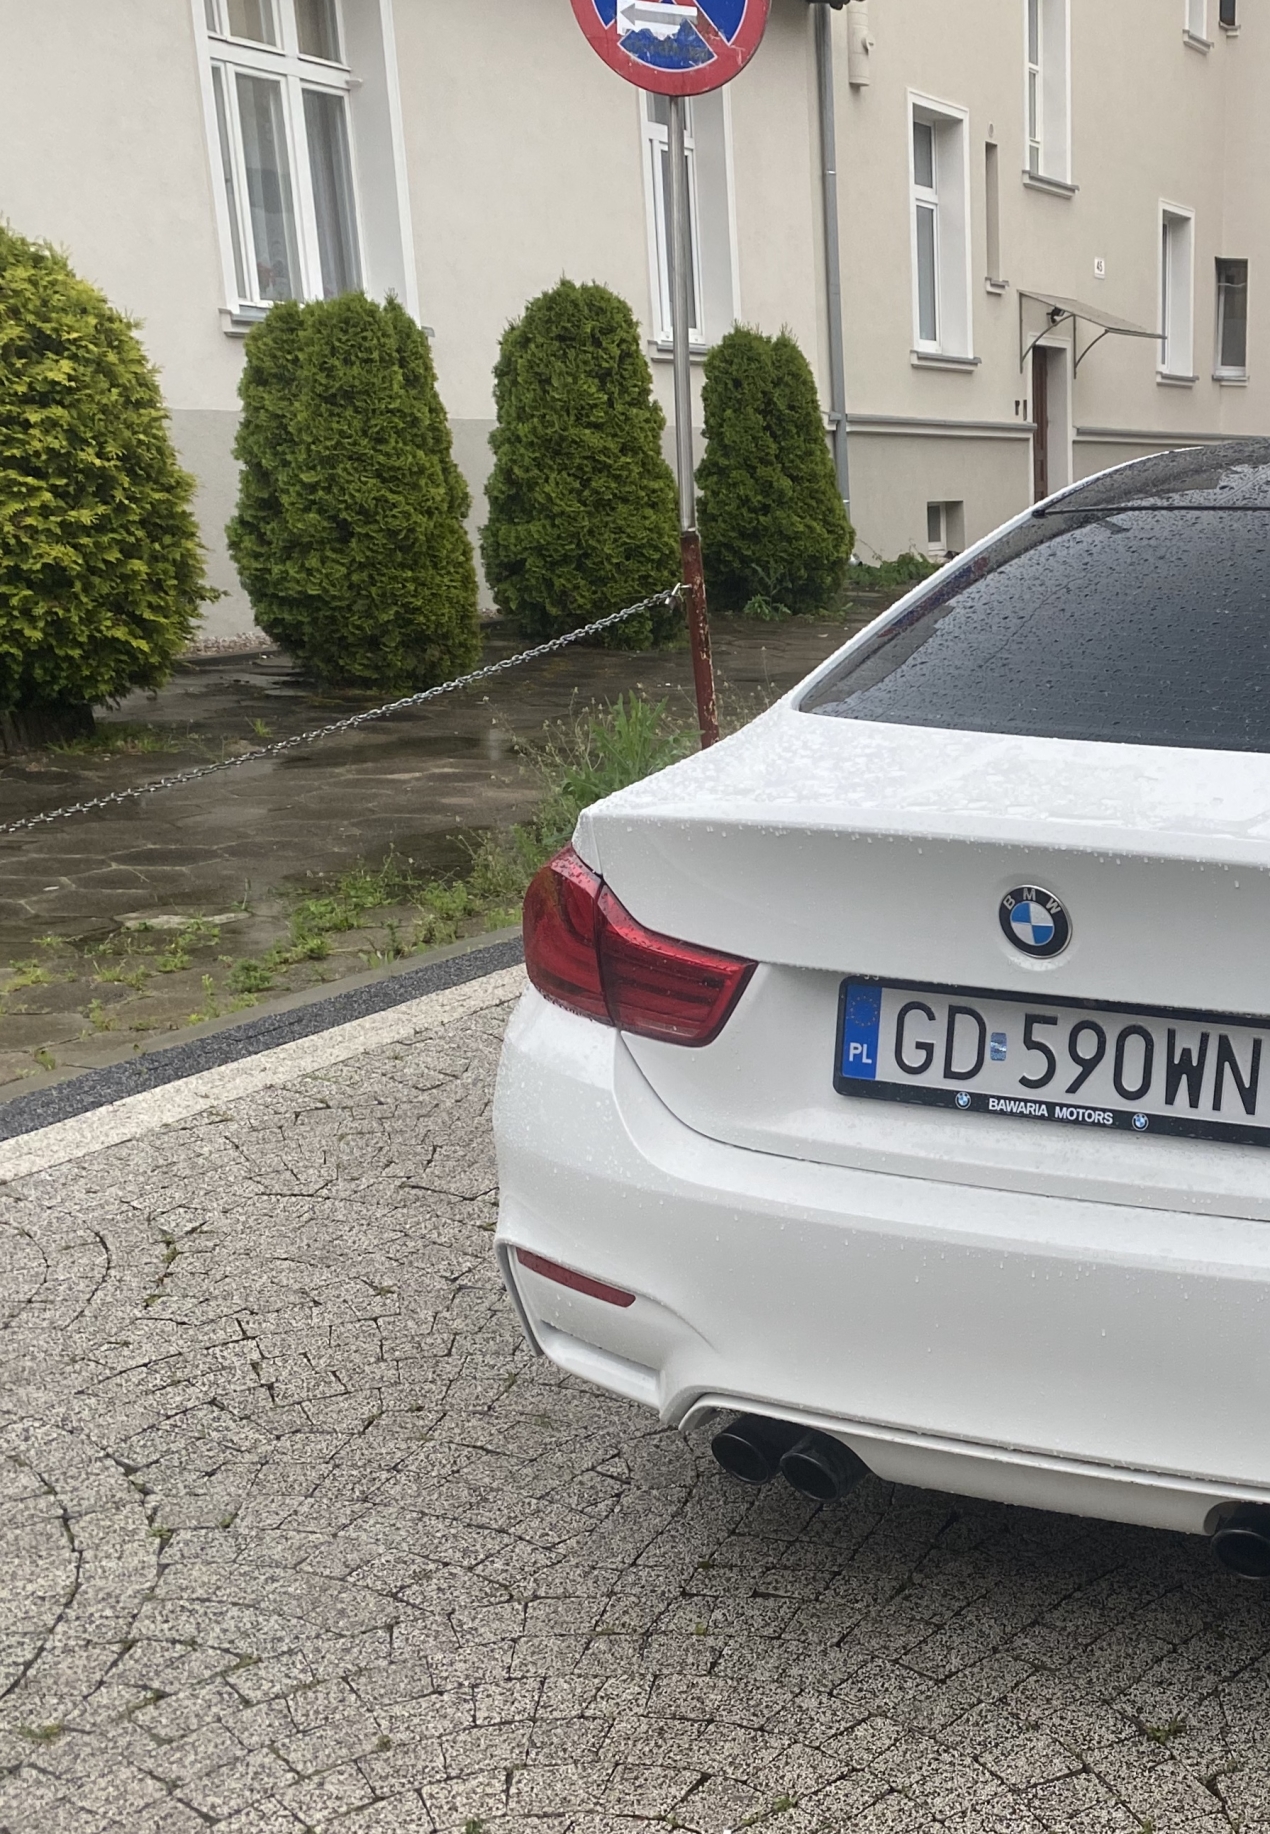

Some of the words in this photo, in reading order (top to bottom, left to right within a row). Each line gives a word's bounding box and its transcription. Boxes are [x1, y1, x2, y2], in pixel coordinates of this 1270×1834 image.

[1002, 887, 1062, 915] BMW
[848, 1043, 872, 1065] PL
[893, 1000, 988, 1081] GD
[1018, 1012, 1264, 1117] 590WN
[988, 1099, 1048, 1118] BAWARIA
[1054, 1106, 1114, 1126] MOTORS
